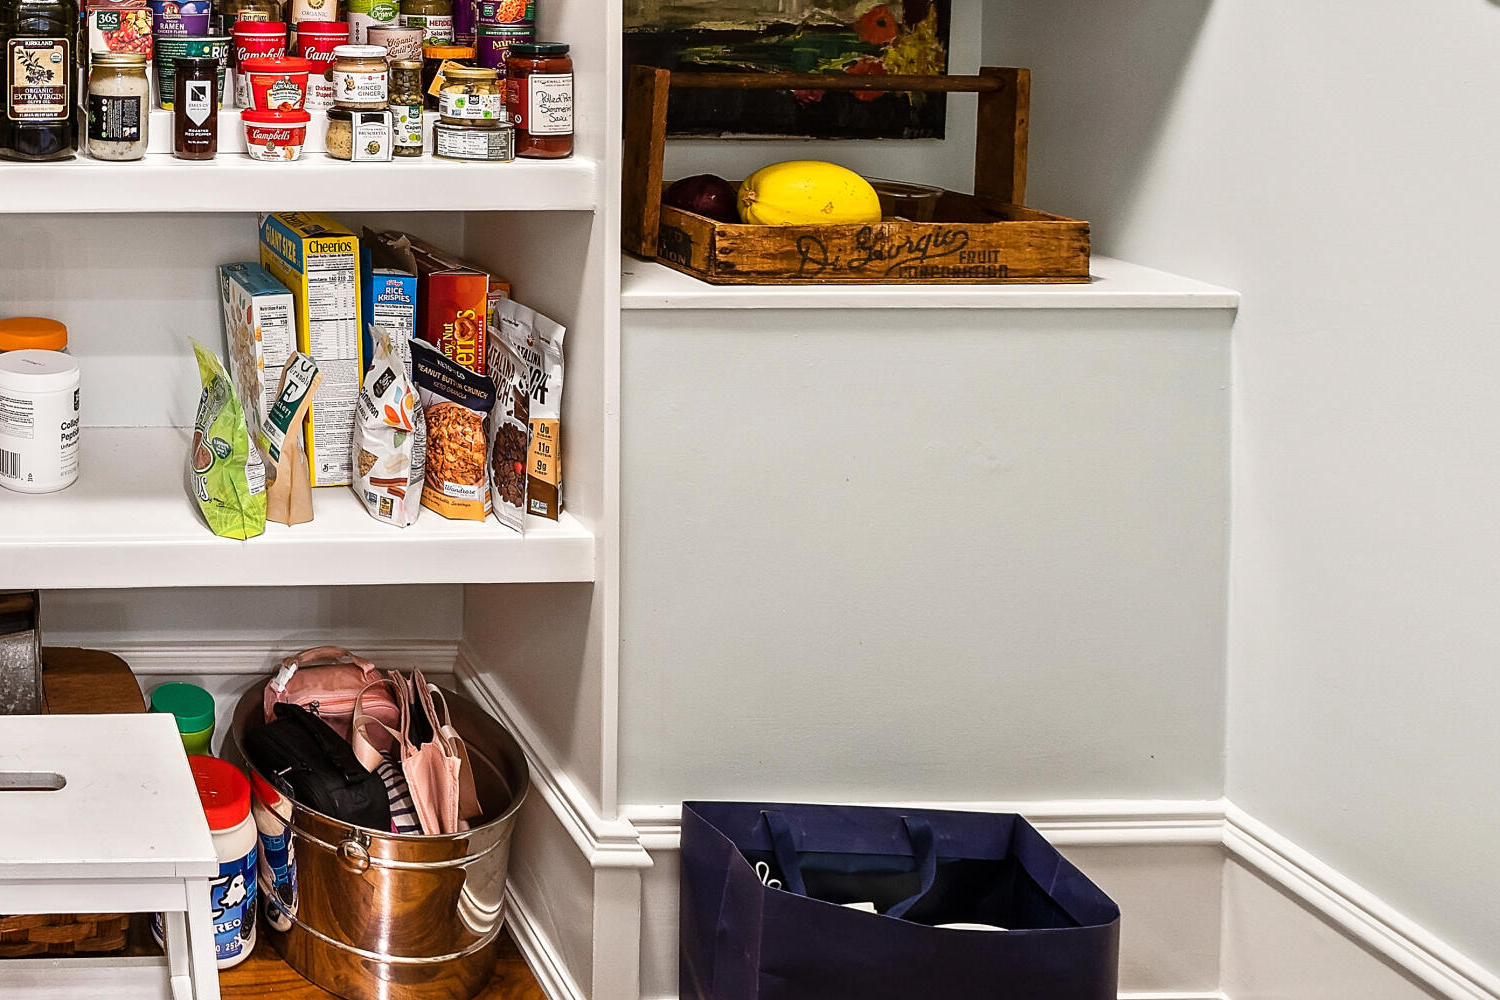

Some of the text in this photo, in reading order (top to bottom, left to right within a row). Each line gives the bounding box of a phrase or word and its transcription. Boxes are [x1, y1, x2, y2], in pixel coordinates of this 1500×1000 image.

[99, 14, 118, 24] 365
[160, 22, 185, 30] RAMEN
[252, 129, 290, 141] Campbell's
[265, 224, 297, 263] GIANT SIZE
[308, 240, 352, 254] Cheerios
[959, 250, 1001, 266] FRUIT
[385, 286, 404, 295] RICE
[377, 294, 411, 303] KRISPIES
[443, 322, 454, 340] Nut
[417, 363, 441, 378] PEANUT
[463, 383, 489, 399] CRUNCH
[538, 441, 550, 454] 11g
[536, 460, 548, 472] 9g
